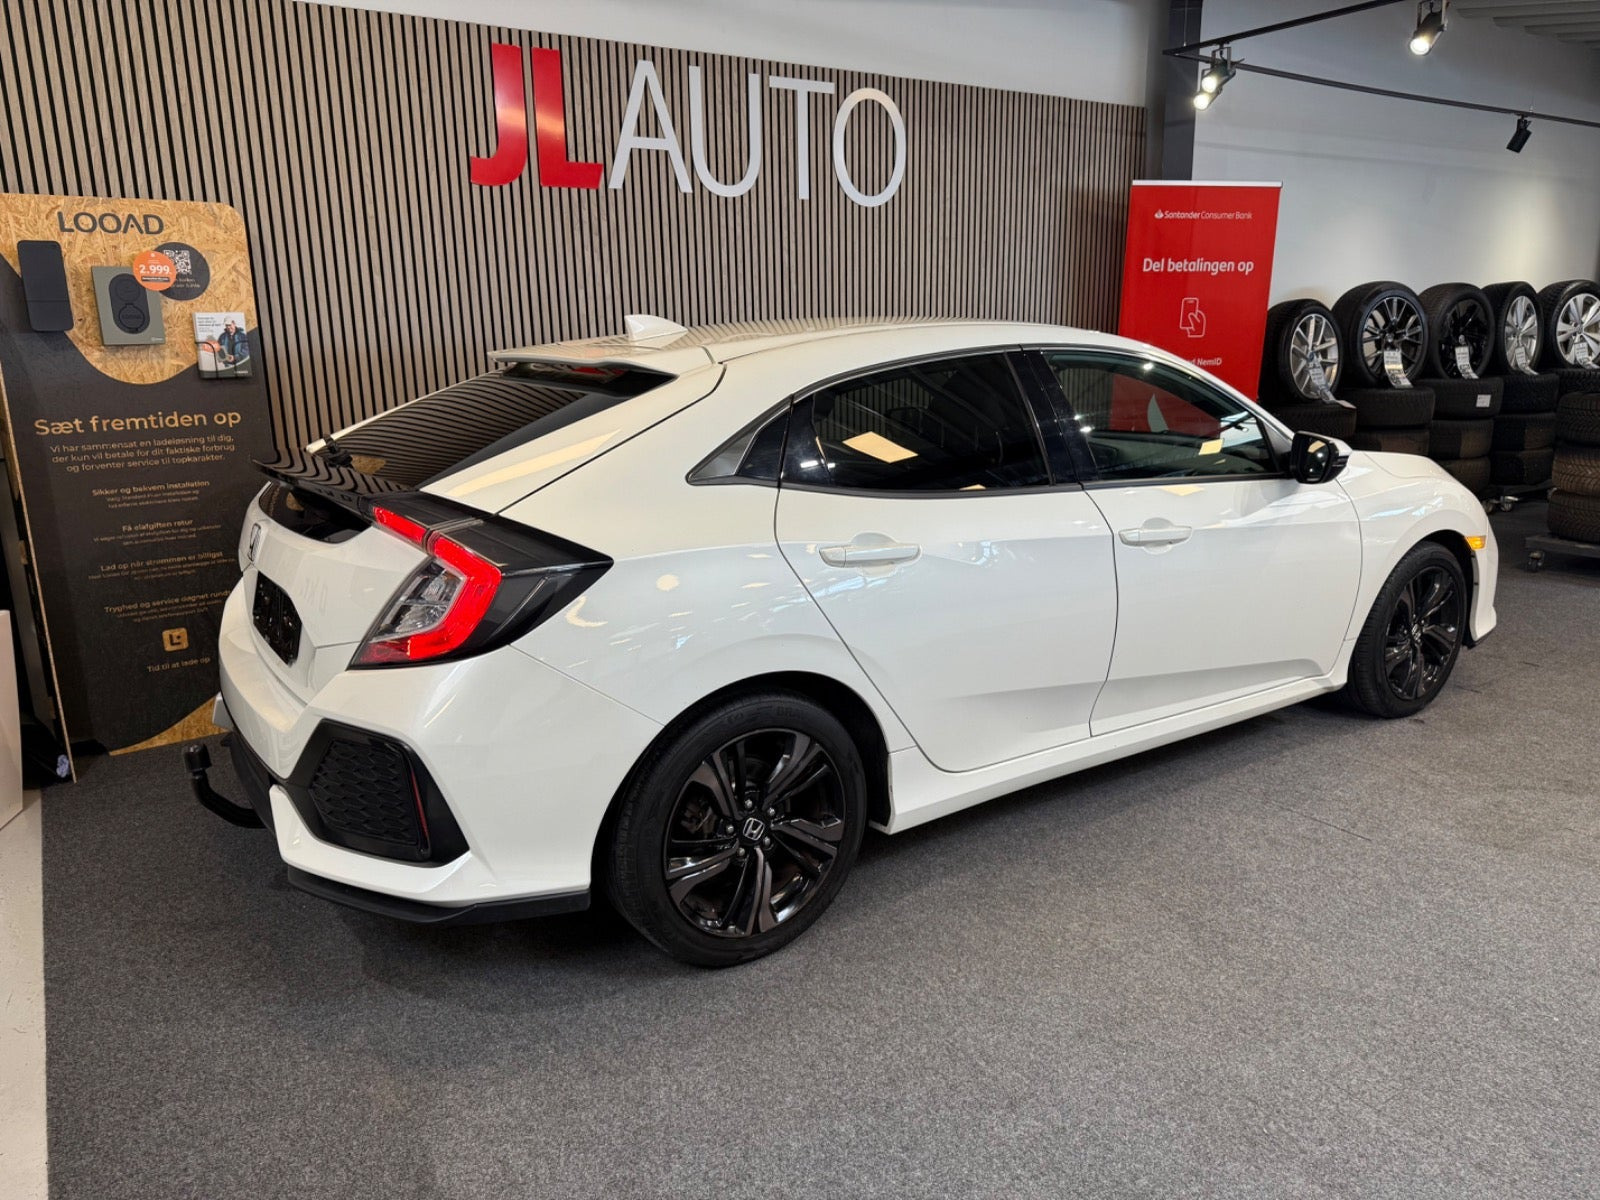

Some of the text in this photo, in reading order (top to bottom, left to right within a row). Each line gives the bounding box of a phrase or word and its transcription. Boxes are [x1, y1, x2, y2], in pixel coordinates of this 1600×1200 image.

[608, 59, 906, 207] AUTO
[1164, 210, 1252, 220] Santander Consumer Bank
[1143, 258, 1254, 275] Del betalingen op
[34, 411, 241, 436] Sæt fremtiden op
[50, 444, 60, 453] Vi
[63, 444, 79, 452] har
[81, 441, 137, 452] sammensat
[52, 455, 69, 463] der
[71, 453, 90, 462] kun
[92, 452, 103, 460] vil
[105, 450, 135, 460] betale
[137, 449, 149, 457] for
[202, 444, 235, 453] forbrug
[66, 465, 80, 473] og
[82, 462, 125, 471] forventer
[127, 459, 160, 468] service
[120, 487, 131, 495] og
